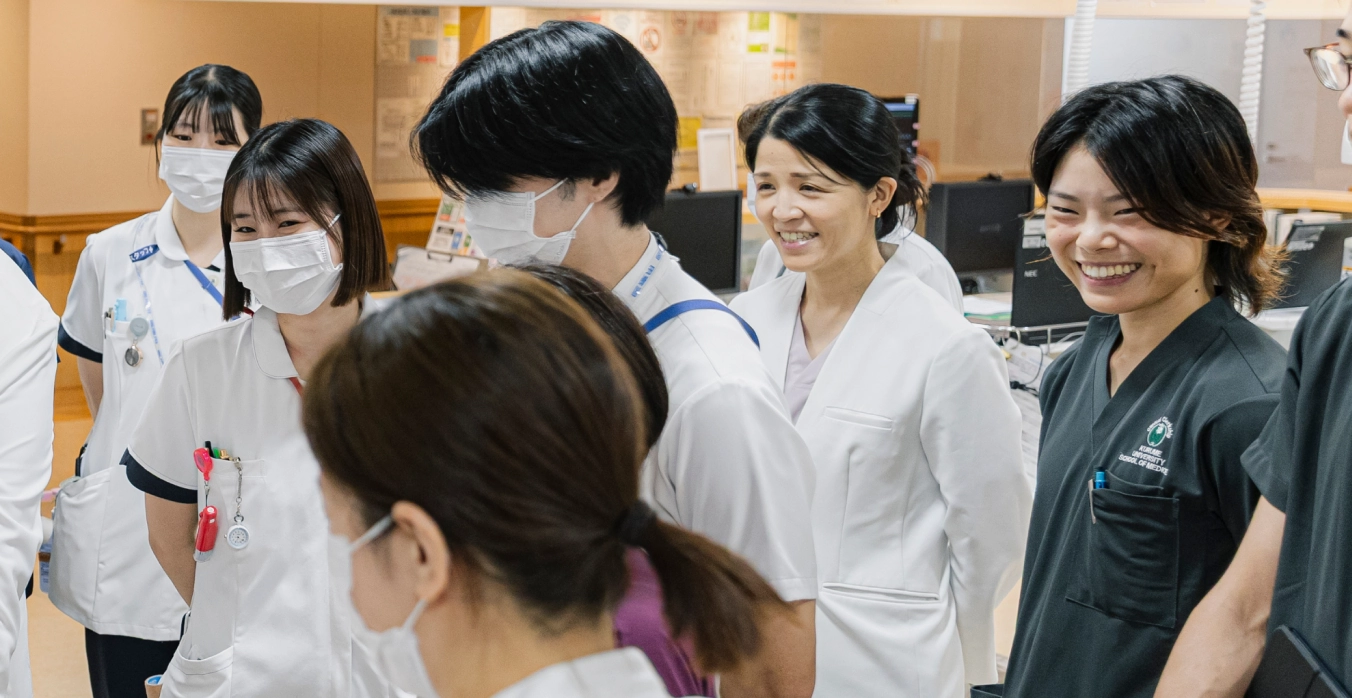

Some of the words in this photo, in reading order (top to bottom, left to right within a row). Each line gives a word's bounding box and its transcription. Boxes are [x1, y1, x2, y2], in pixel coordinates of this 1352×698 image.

[1024, 269, 1038, 277] NEC
[1132, 450, 1166, 466] UNIVERSITY
[1139, 445, 1163, 458] KURUME
[1118, 454, 1138, 465] SCHOOL
[1138, 460, 1147, 468] OF
